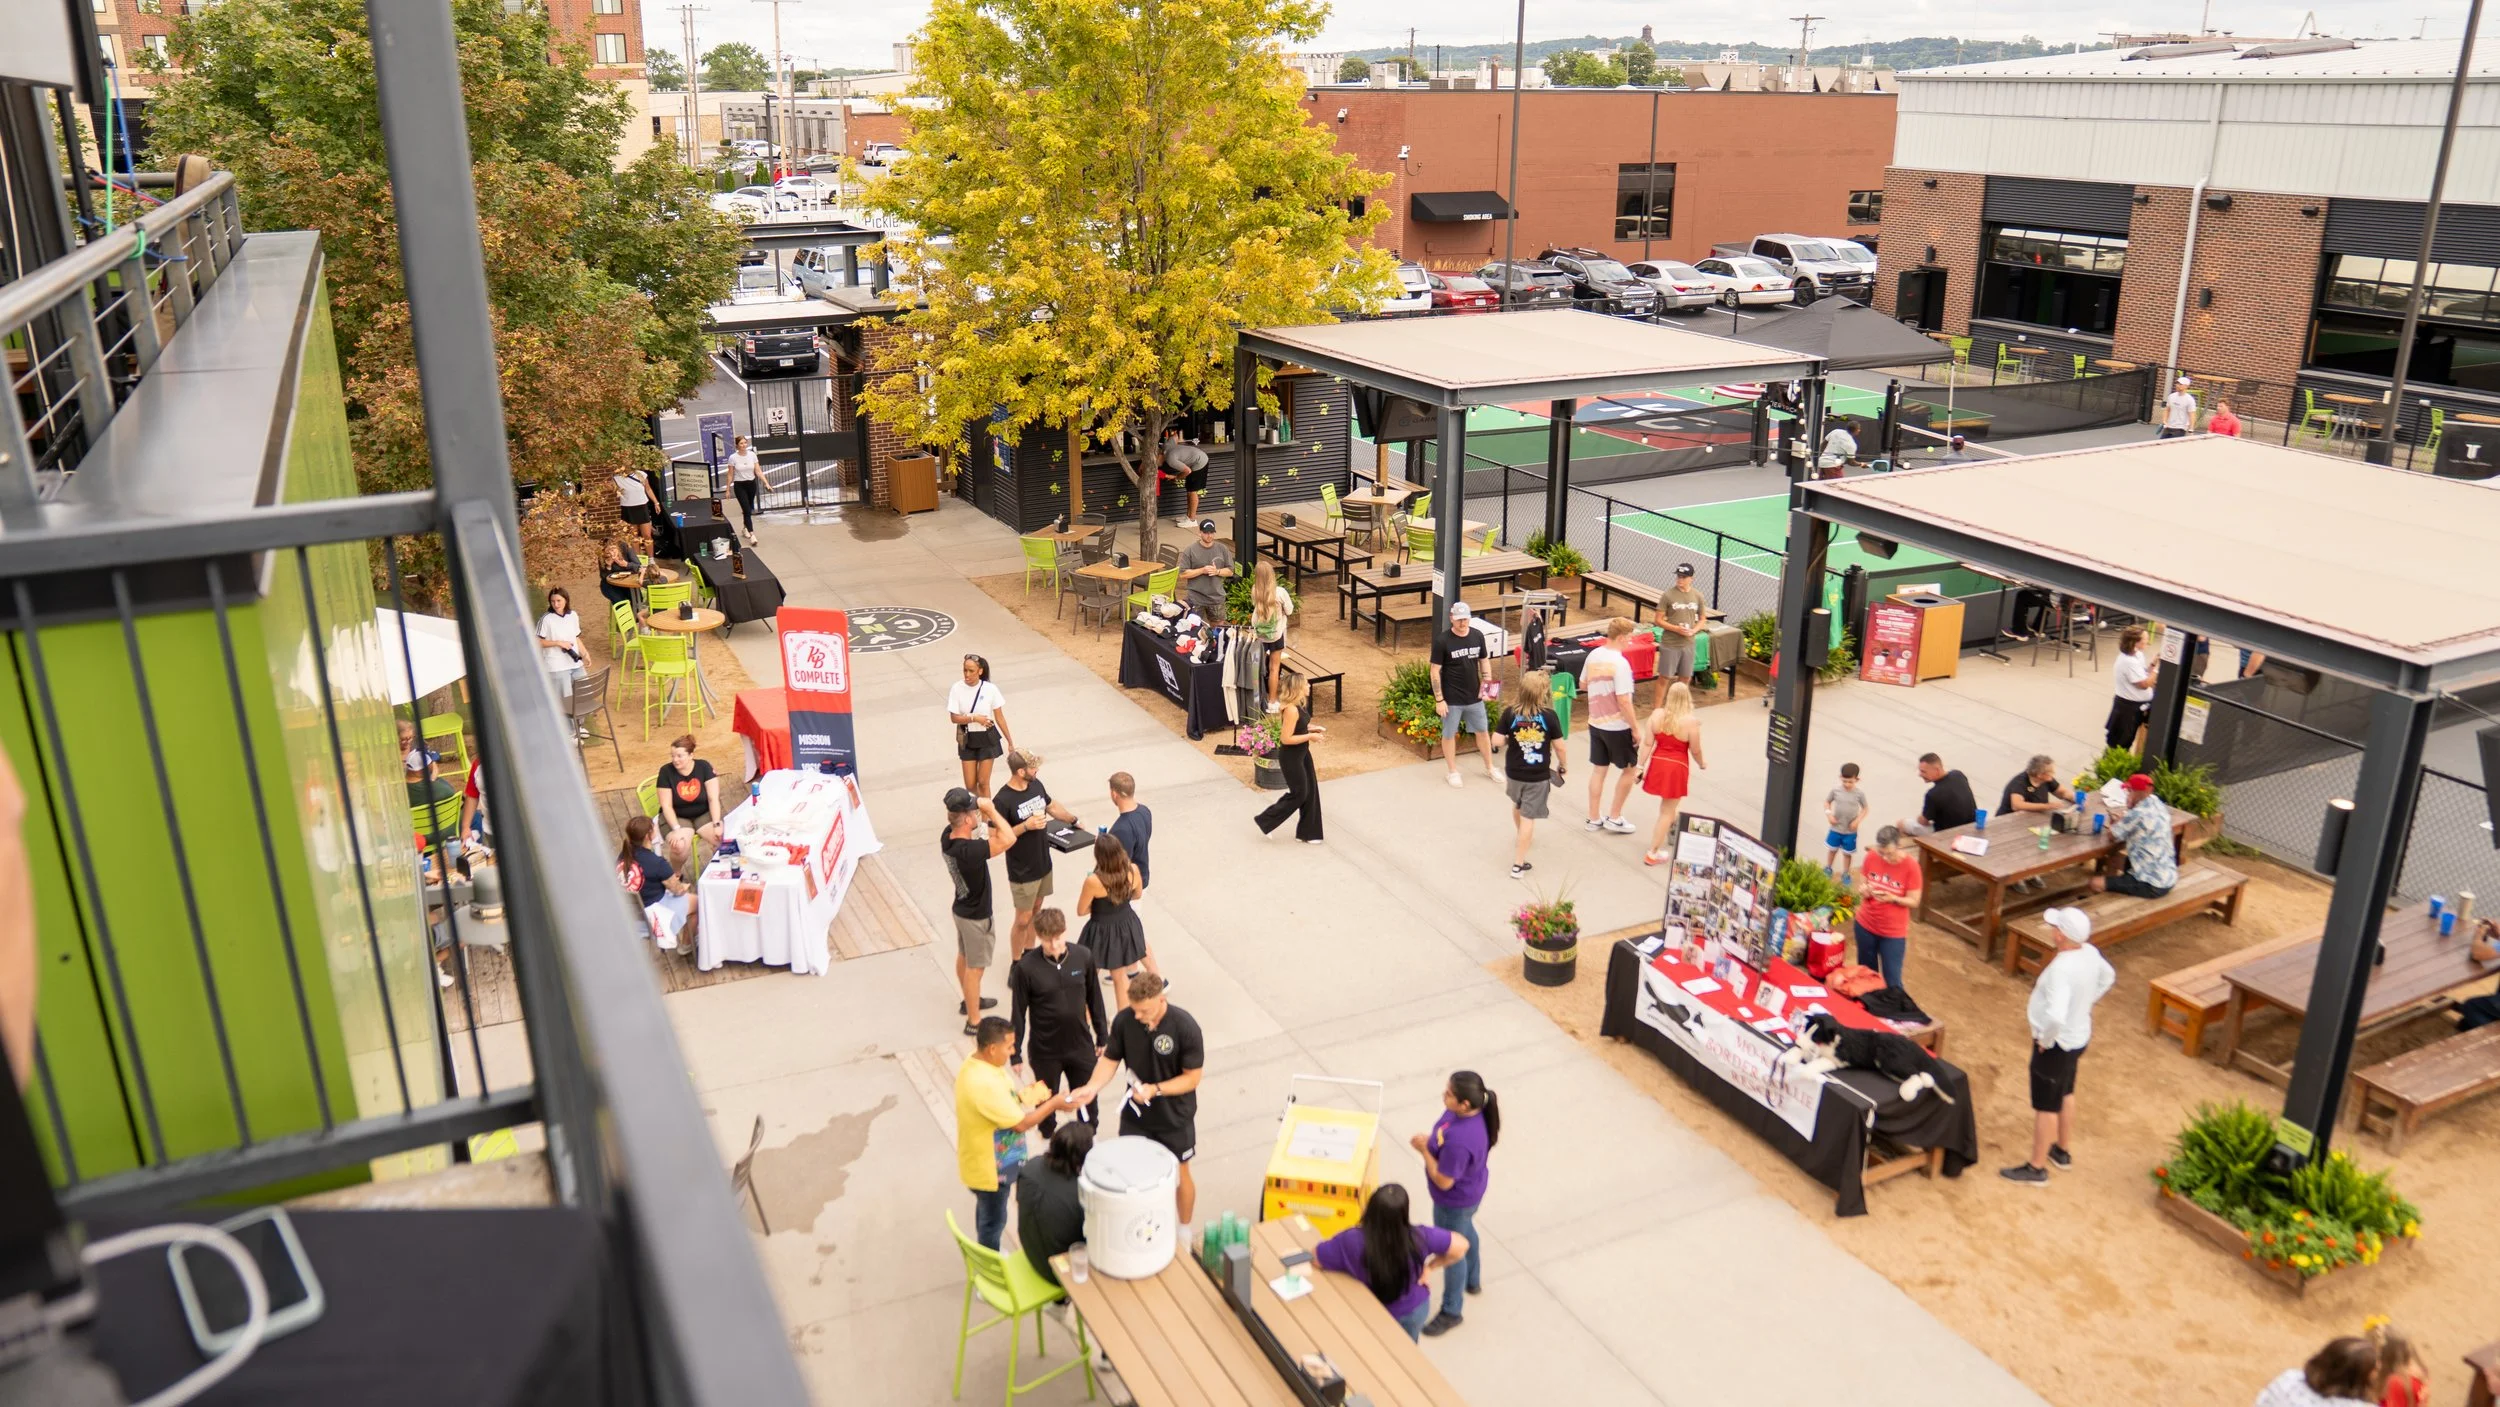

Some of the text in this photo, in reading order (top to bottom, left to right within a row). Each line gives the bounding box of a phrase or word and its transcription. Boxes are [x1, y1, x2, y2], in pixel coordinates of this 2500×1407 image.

[1451, 648, 1469, 659] NEVER
[795, 670, 840, 685] COMPLETE
[798, 734, 831, 746] MISSION
[1705, 1037, 1759, 1079] BORDER
